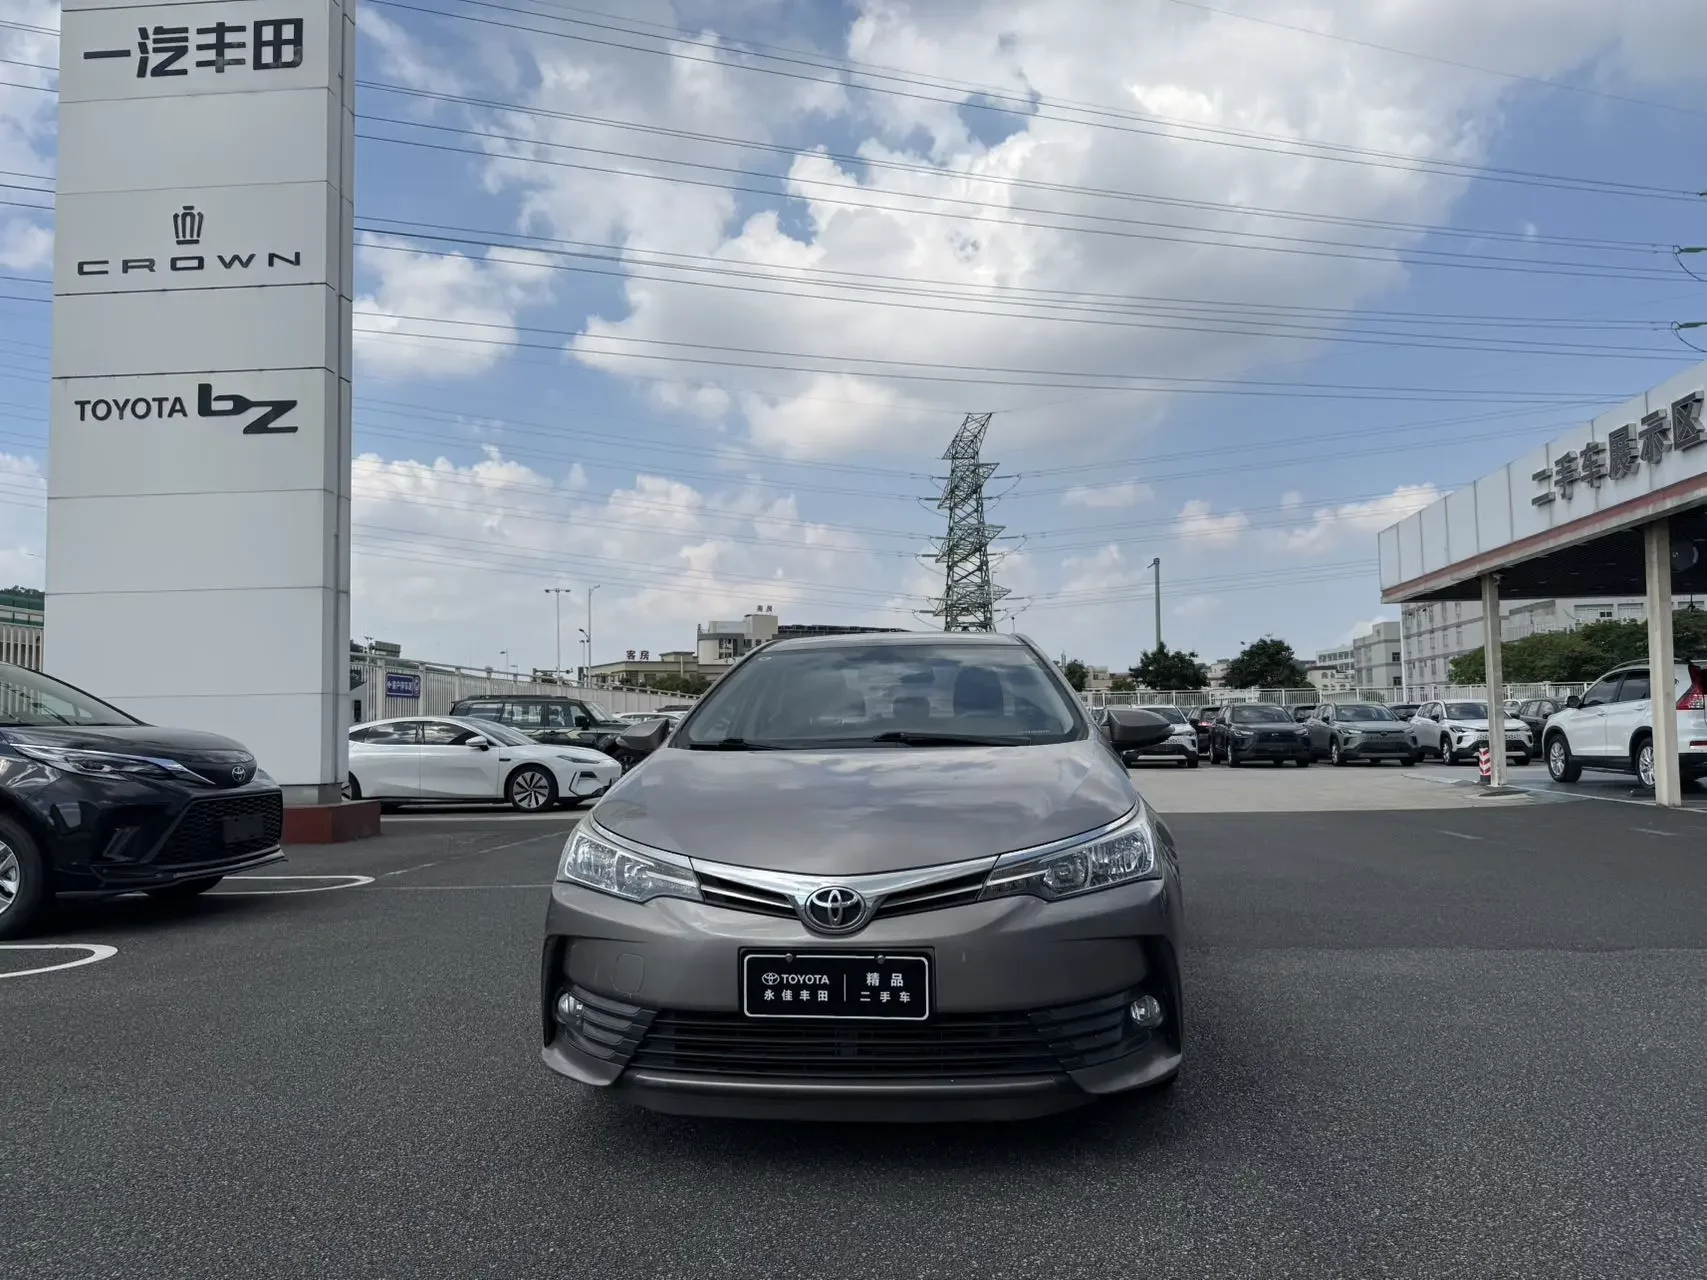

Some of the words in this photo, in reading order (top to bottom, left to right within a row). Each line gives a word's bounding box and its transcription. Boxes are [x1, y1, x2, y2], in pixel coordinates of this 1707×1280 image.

[83, 18, 303, 78] 一汽丰田
[77, 251, 300, 276] CROWN
[74, 396, 188, 421] TOYOTA
[1531, 390, 1707, 506] 二手车展示区
[626, 649, 649, 660] 客房
[781, 974, 830, 985] TOYOTA
[866, 972, 904, 987] 精品
[763, 989, 828, 1002] 永佳丰田
[860, 991, 911, 1003] 二手车
